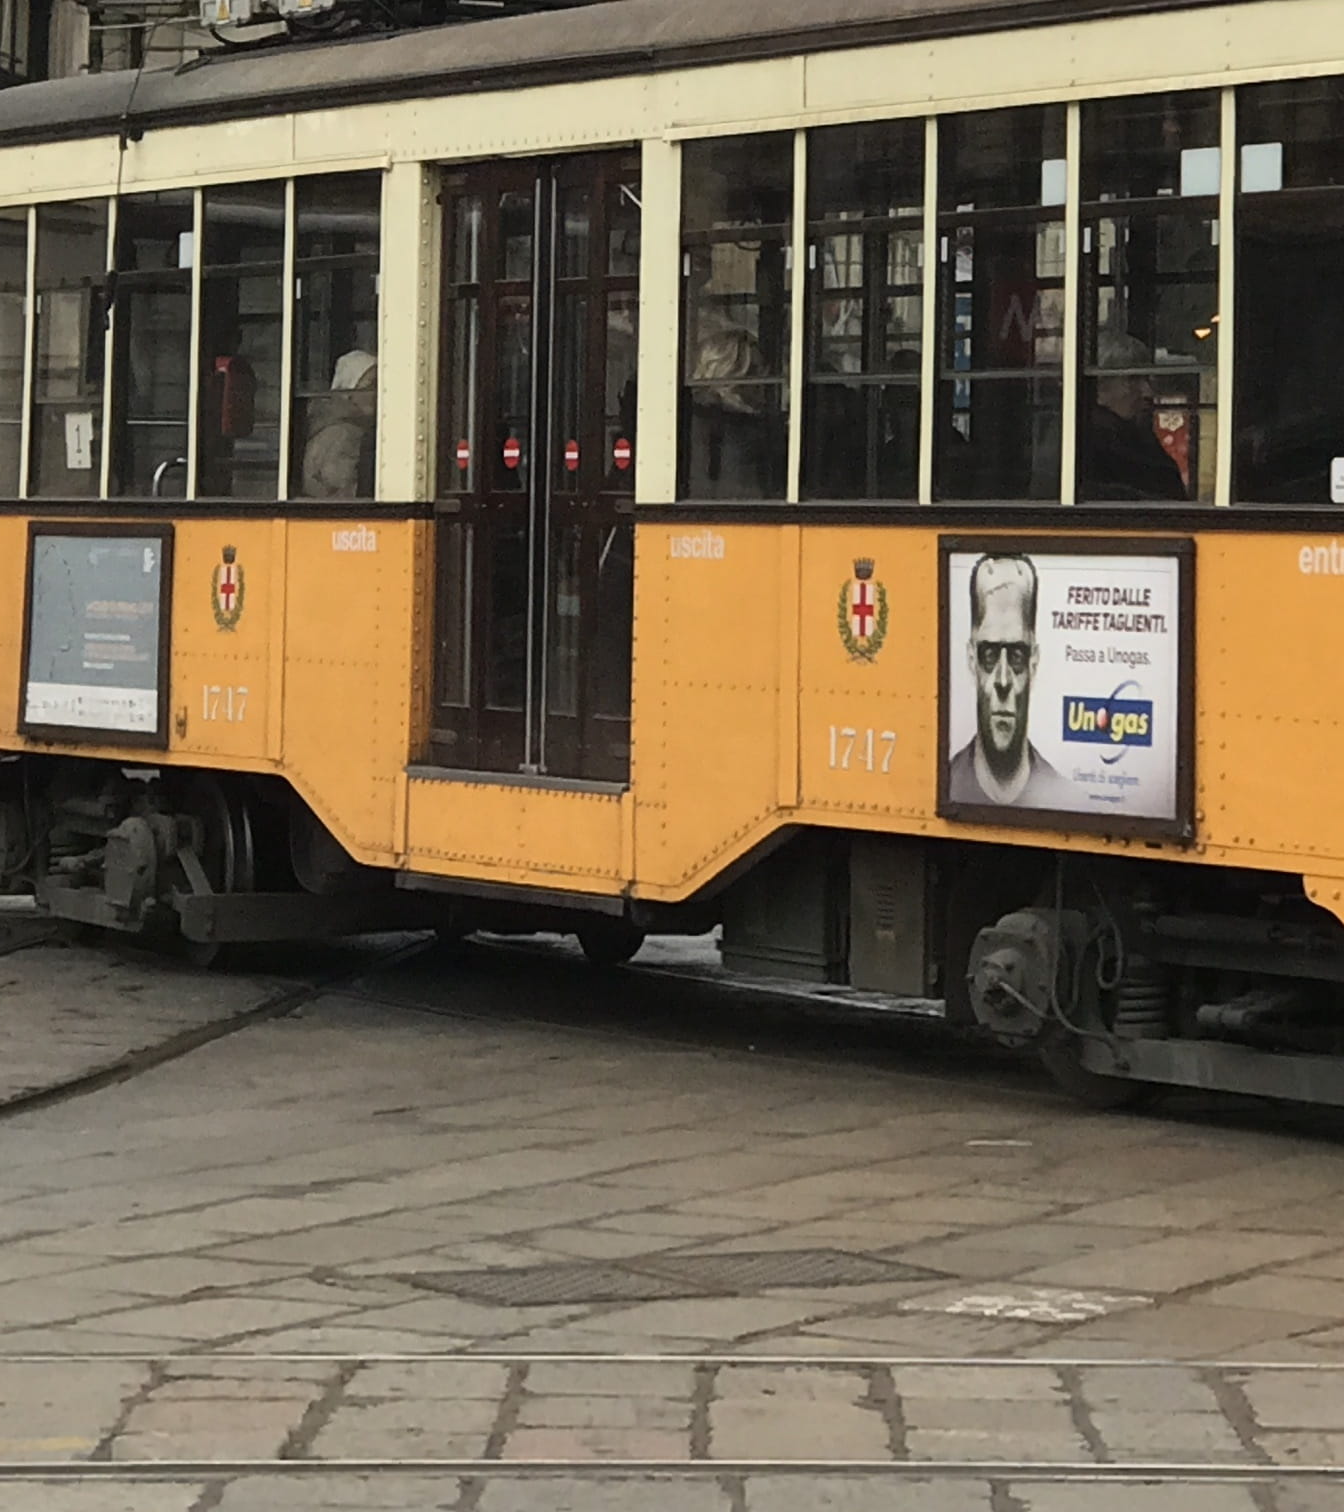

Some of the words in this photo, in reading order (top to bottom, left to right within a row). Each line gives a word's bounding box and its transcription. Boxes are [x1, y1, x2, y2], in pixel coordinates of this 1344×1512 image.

[331, 523, 377, 552] uscita
[670, 529, 725, 559] uscita
[1067, 586, 1111, 606] FERITO
[1112, 587, 1152, 607] DALLE
[1051, 610, 1100, 631] TARIFFE
[1065, 644, 1096, 663] Passa
[1098, 651, 1106, 663] a
[828, 725, 898, 773] 1747
